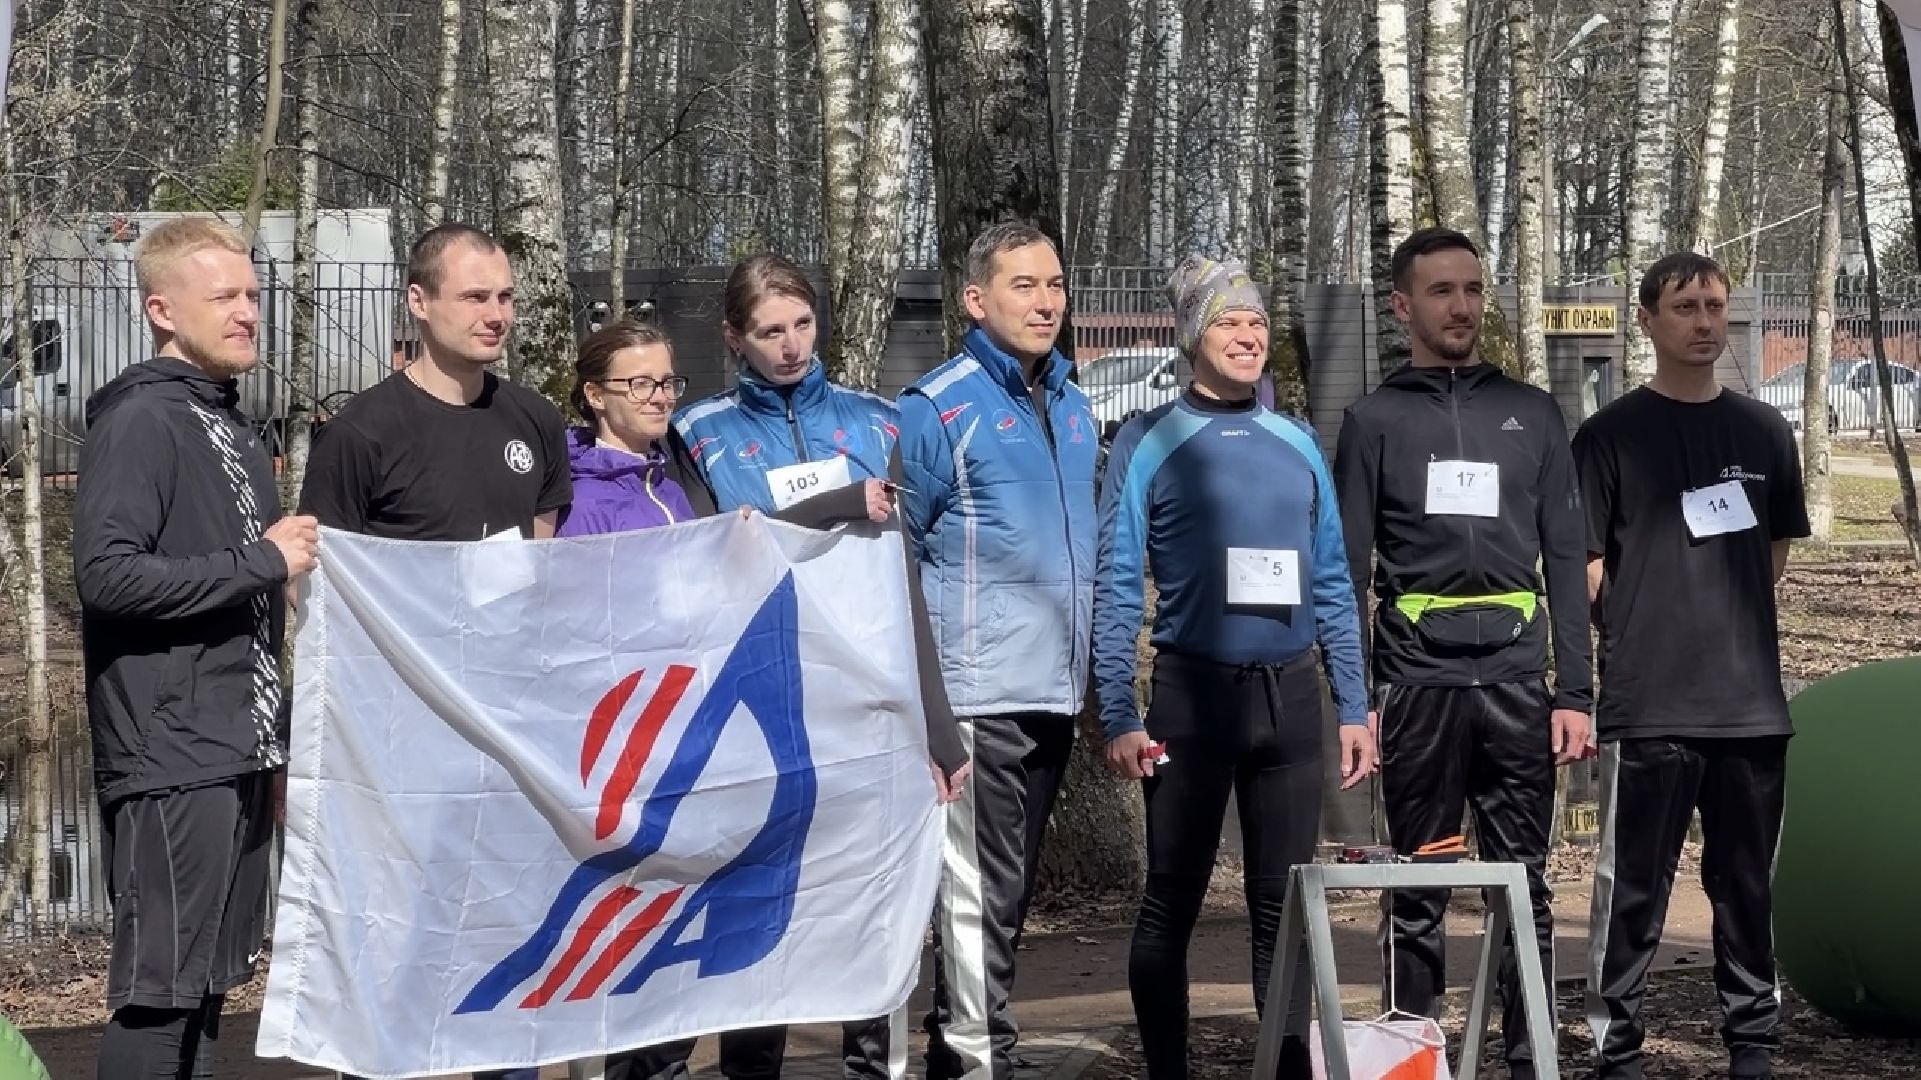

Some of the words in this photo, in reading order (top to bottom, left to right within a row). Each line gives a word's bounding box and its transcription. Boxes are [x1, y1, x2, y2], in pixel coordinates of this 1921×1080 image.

[1541, 309, 1570, 329] УНКТ
[1573, 309, 1614, 329] ОХРАНЫ
[786, 472, 819, 493] 103
[1457, 471, 1476, 487] 17
[1708, 497, 1729, 514] 14
[1272, 561, 1283, 576] 5
